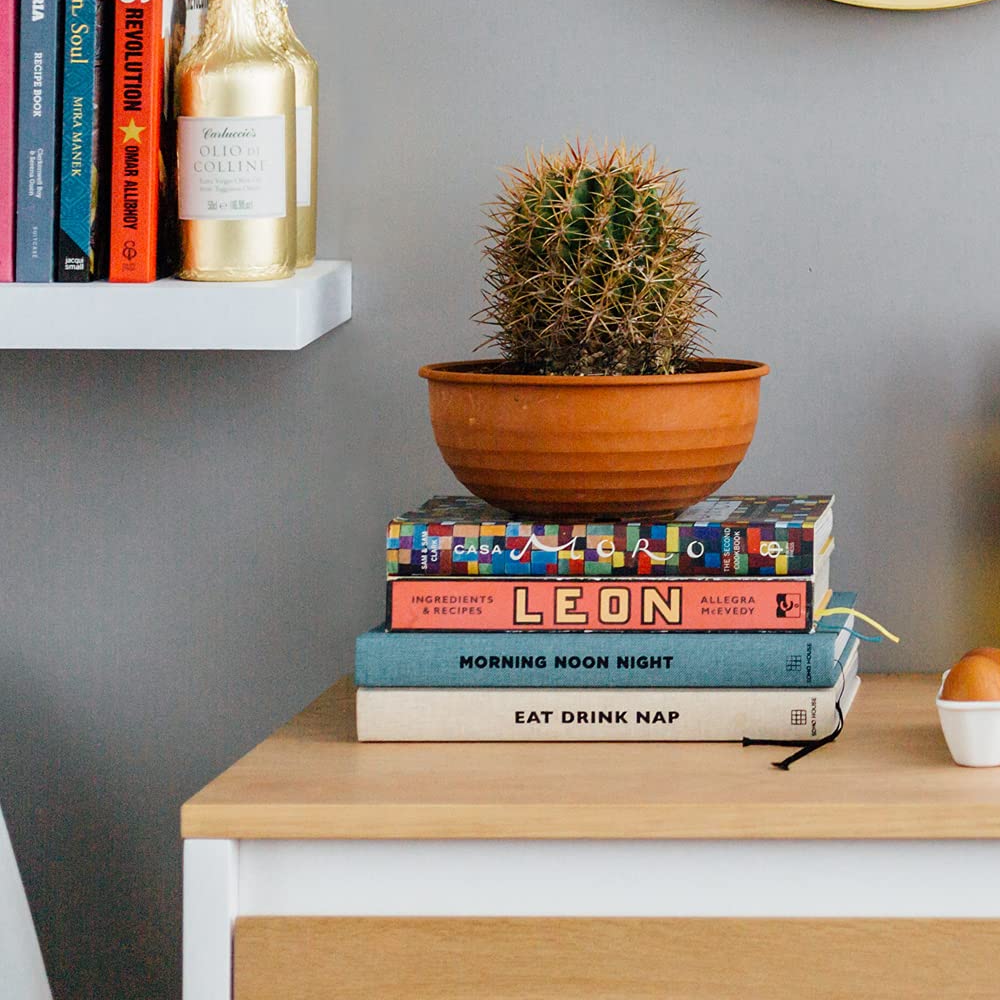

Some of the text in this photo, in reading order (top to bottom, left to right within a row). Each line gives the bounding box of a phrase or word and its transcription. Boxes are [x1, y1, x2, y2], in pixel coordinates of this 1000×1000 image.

[70, 23, 89, 64] Soul
[123, 8, 144, 111] REVOLUTION
[34, 52, 43, 87] RECIPE
[32, 88, 42, 117] BOOK
[71, 96, 83, 177] MIRA MANEK
[203, 127, 256, 139] Carluccio's
[199, 145, 242, 157] OLIO
[123, 145, 139, 230] OMAR ALLIBHOY
[454, 544, 502, 555] CASA
[733, 531, 741, 570] COOKBOOK
[411, 595, 494, 604] INGREDIENTS
[513, 586, 682, 625] LEON
[700, 596, 756, 604] ALLEGRA
[423, 607, 482, 615] & RECIPES
[701, 607, 755, 615] McEVEDY
[459, 655, 673, 669] MORNING NOON NIGHT
[514, 711, 680, 724] EAT DRINK NAP
